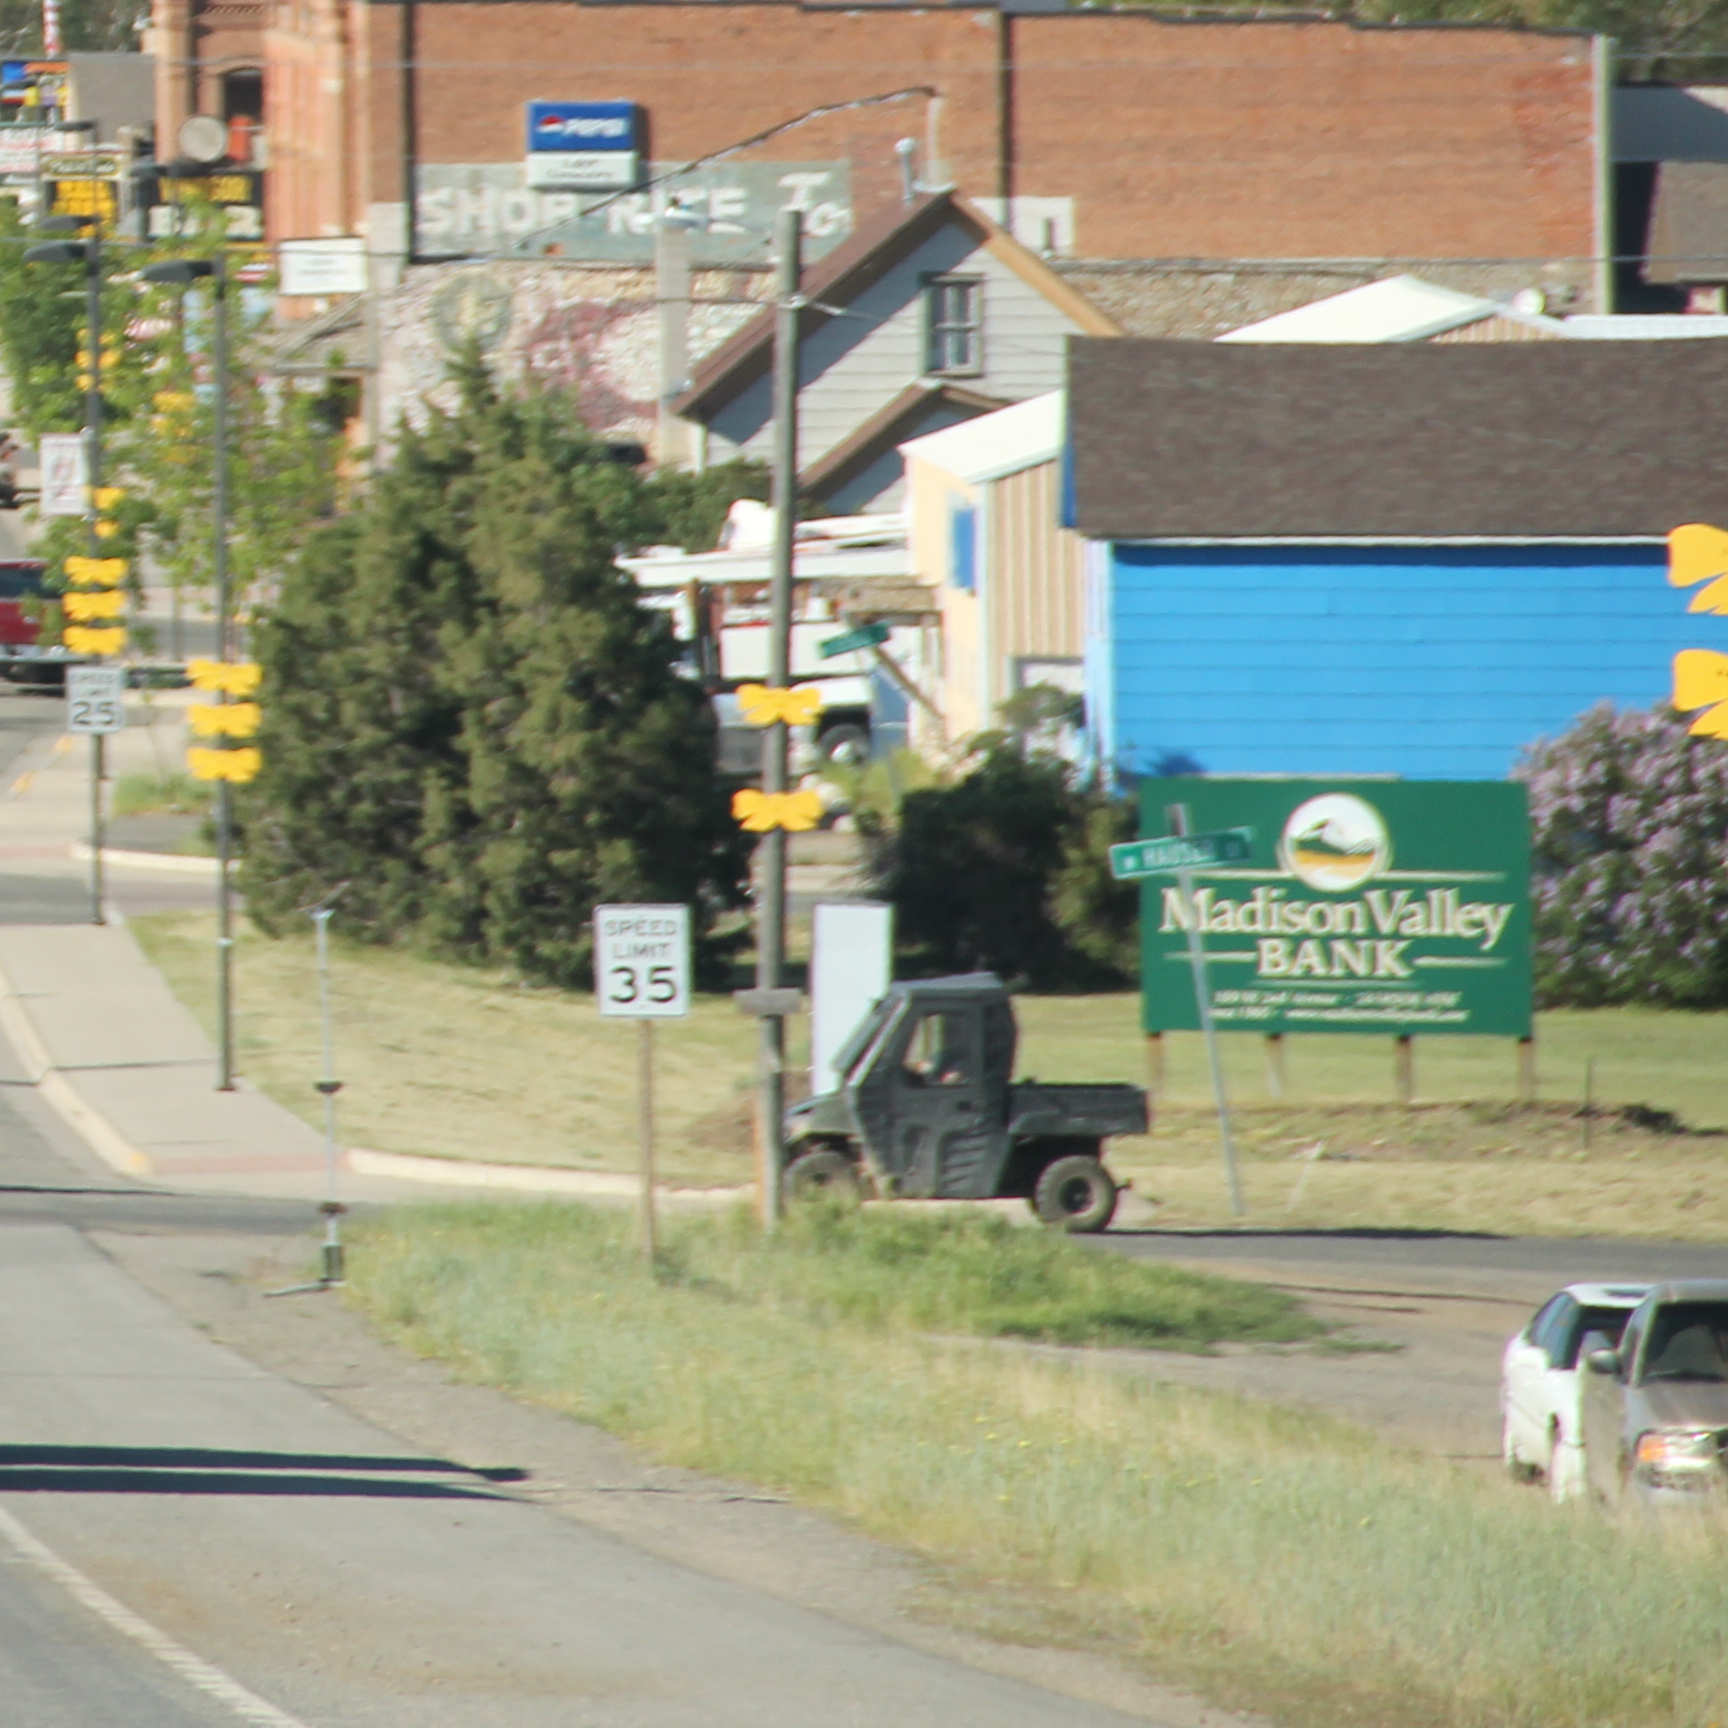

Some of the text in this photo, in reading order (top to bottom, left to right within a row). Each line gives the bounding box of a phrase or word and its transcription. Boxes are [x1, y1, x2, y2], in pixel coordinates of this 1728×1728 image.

[563, 118, 630, 138] PEPSI
[417, 186, 579, 235] SHOP
[72, 701, 115, 725] 25
[605, 919, 677, 936] SPEED
[1158, 885, 1516, 952] Madison Valley
[612, 942, 670, 959] LIMIT
[1256, 937, 1415, 979] BANK
[609, 965, 677, 1004] 35
